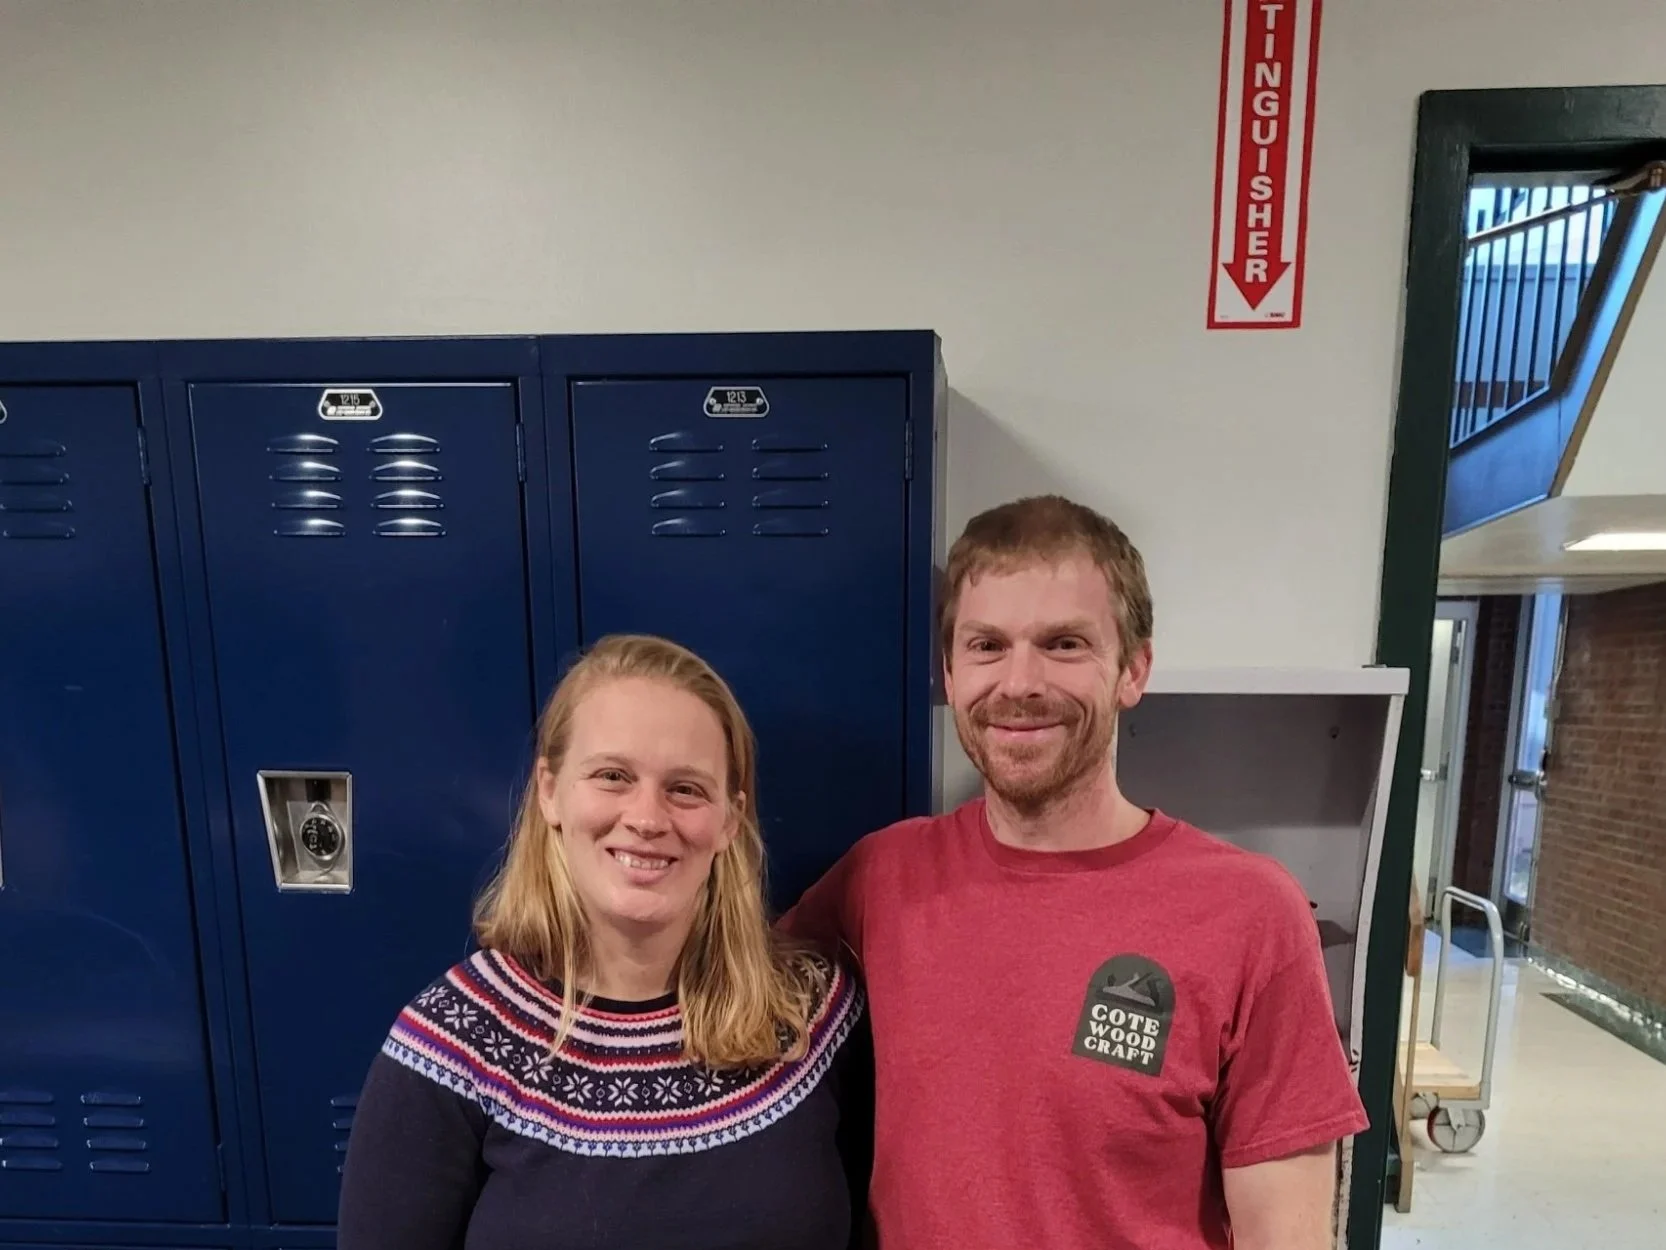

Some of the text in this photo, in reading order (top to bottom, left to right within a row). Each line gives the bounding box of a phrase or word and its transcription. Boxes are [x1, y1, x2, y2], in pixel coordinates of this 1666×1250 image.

[1245, 3, 1284, 284] TINGUISHER
[726, 390, 748, 403] 1213
[1089, 1020, 1156, 1050] WOOD
[1091, 1003, 1160, 1037] COTE
[1083, 1035, 1154, 1065] CRAFT
